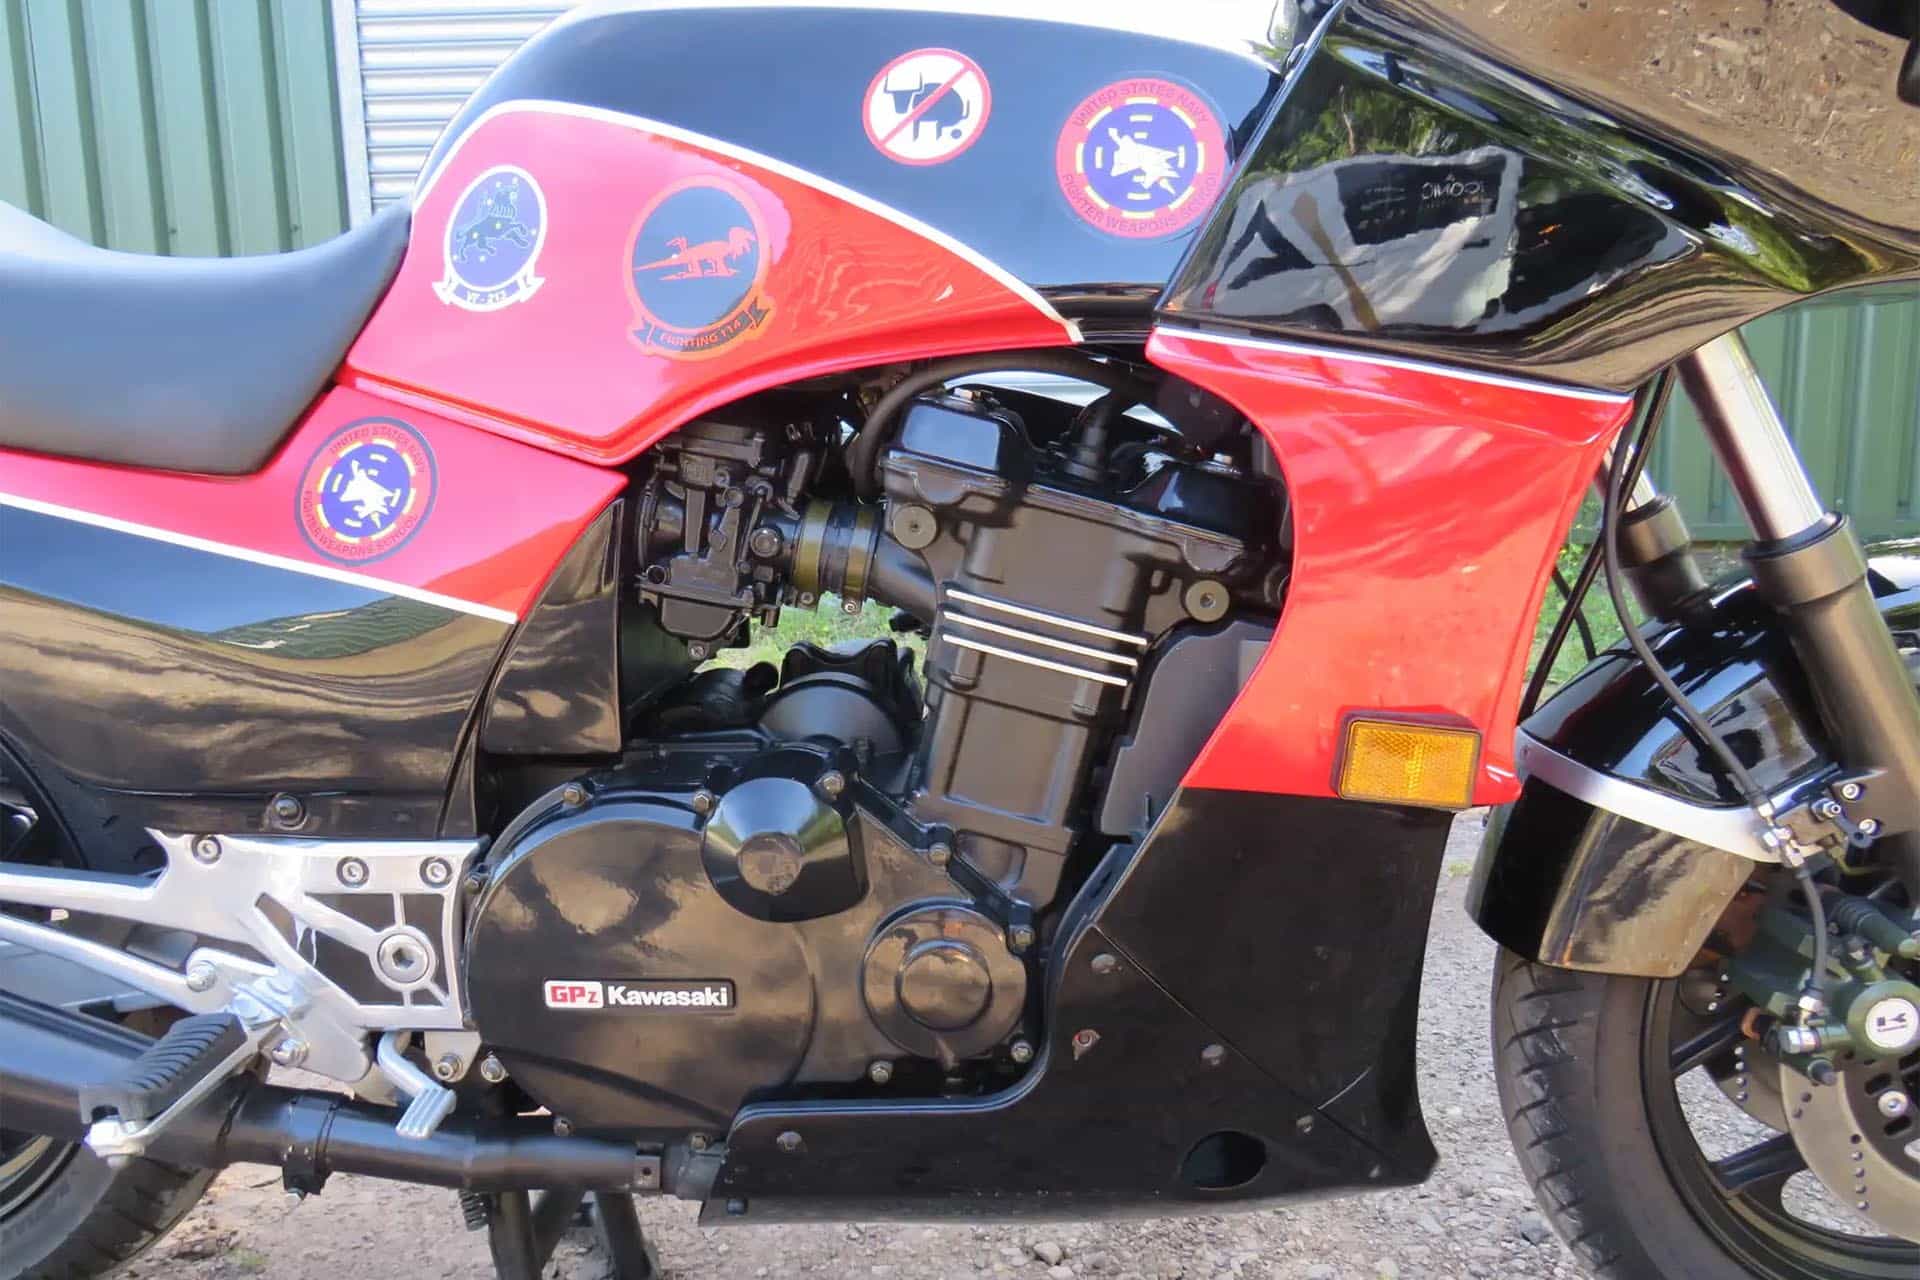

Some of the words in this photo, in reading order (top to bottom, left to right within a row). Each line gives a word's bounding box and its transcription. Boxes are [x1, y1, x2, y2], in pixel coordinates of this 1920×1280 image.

[1072, 89, 1118, 127] UNITED
[1120, 81, 1176, 98] STATES
[1177, 92, 1209, 125] NAVY
[1062, 173, 1106, 223] FIGHTER
[1106, 214, 1178, 233] WEAPONS
[660, 331, 718, 347] FIGHTING
[329, 427, 370, 455] UNITED
[372, 425, 410, 446] STATES
[607, 985, 728, 1007] Kawasaki
